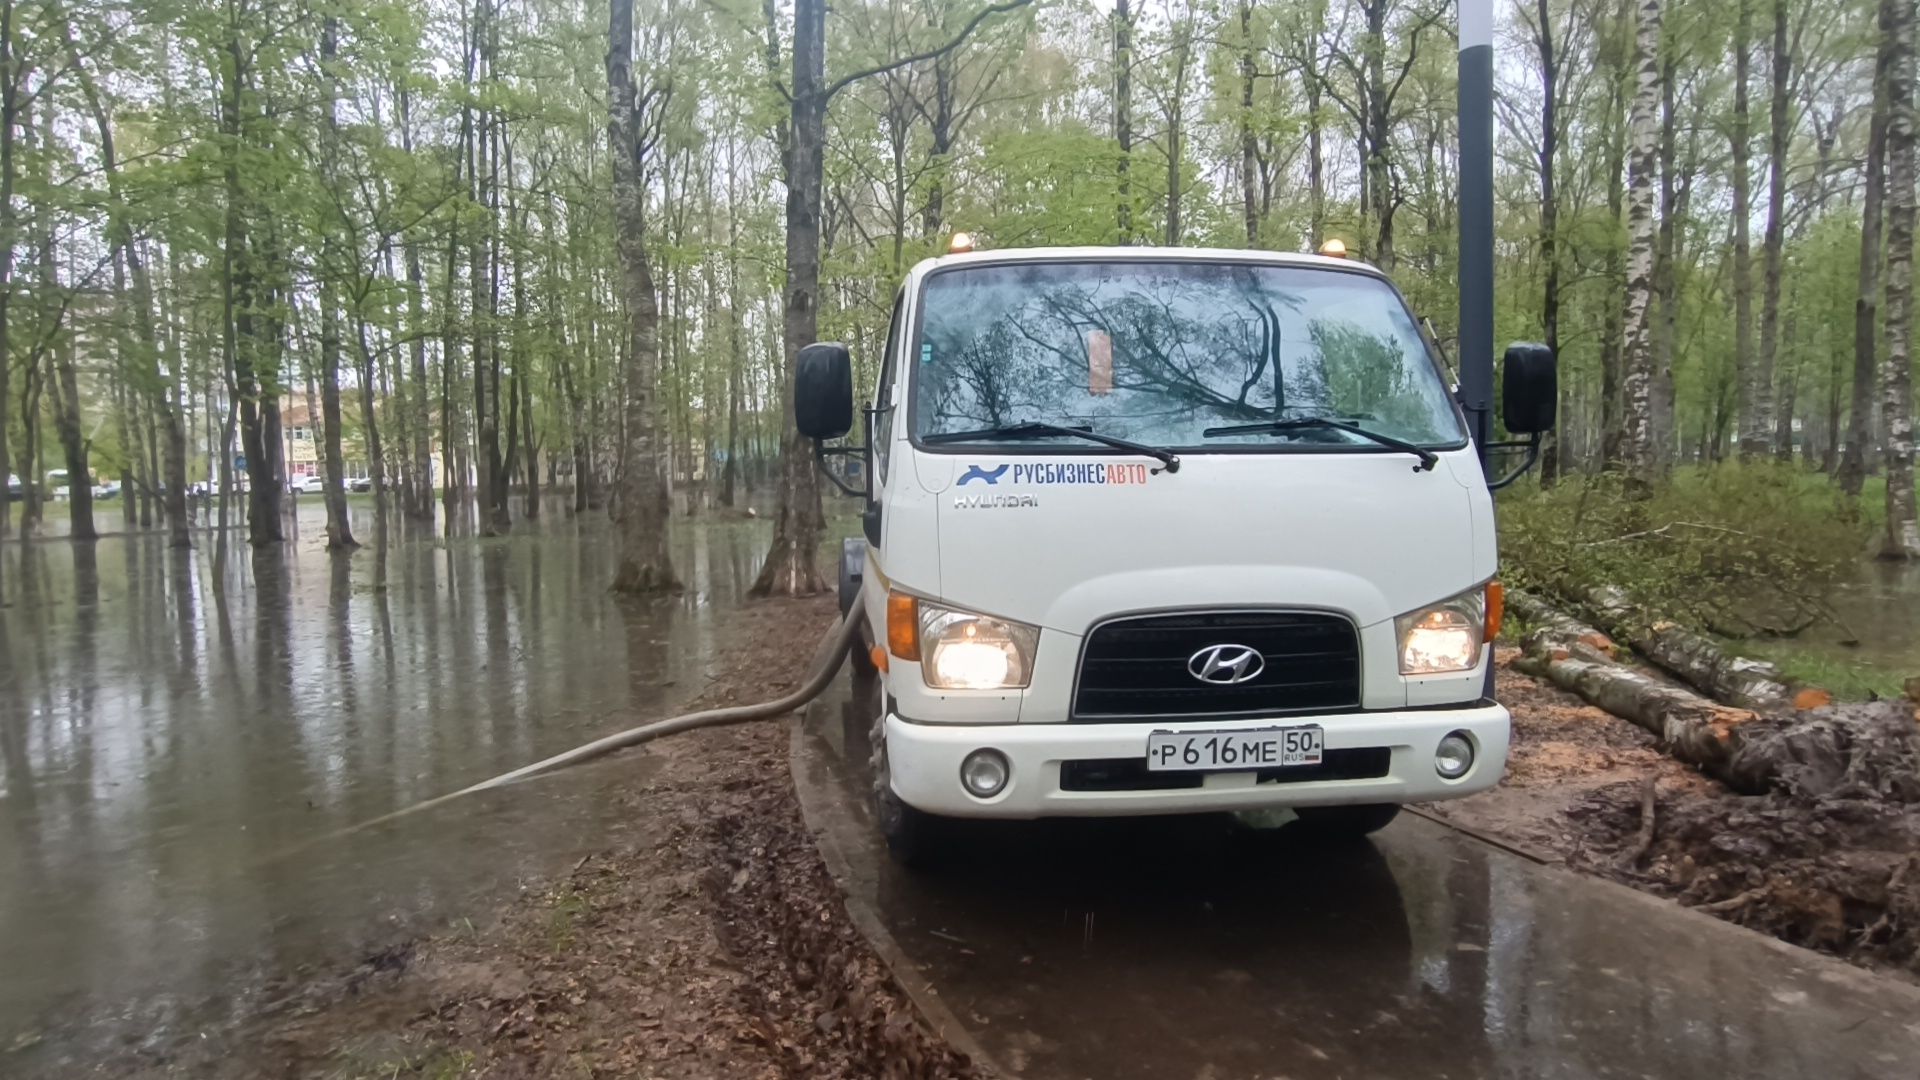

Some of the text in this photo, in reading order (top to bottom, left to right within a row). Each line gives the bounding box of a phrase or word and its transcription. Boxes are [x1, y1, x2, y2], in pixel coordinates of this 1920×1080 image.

[1013, 463, 1147, 485] РУСБИЗНЕСАВТО
[953, 492, 1039, 509] HYUNDAI
[1286, 731, 1313, 753] 50
[1284, 752, 1305, 762] RUS
